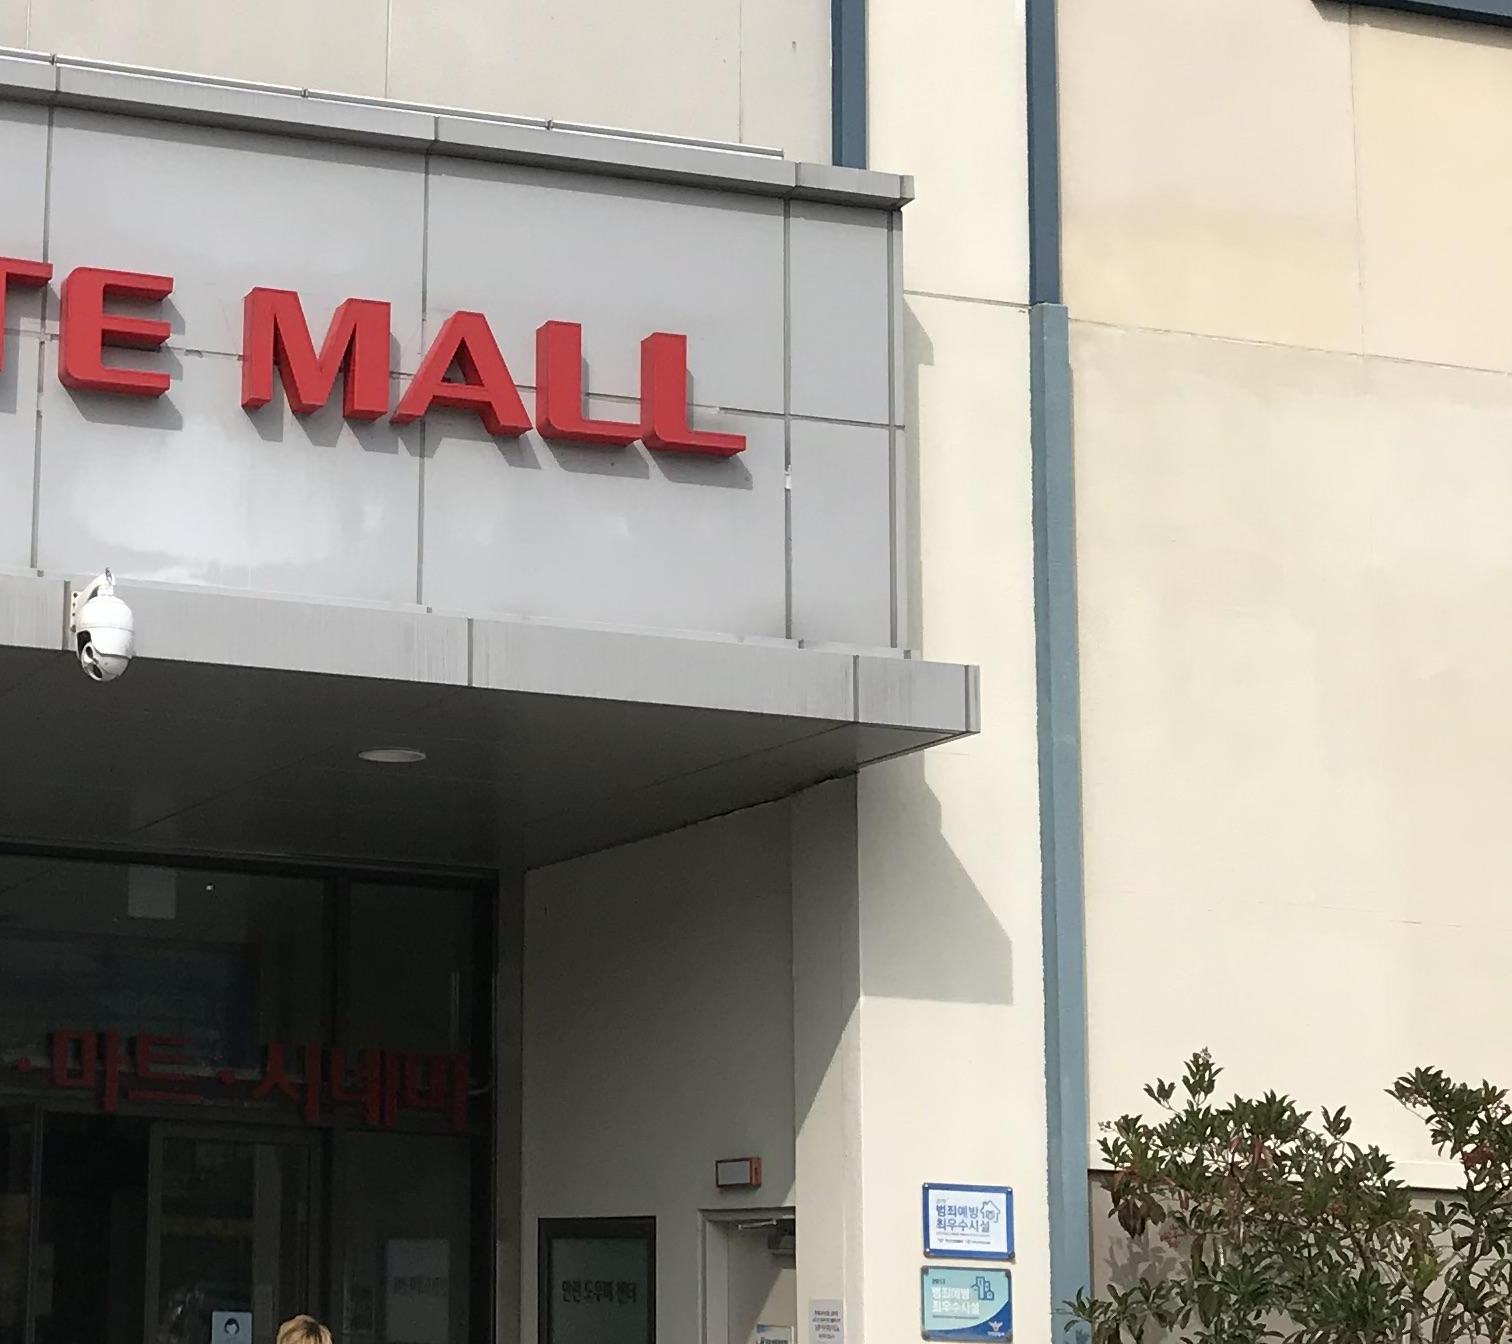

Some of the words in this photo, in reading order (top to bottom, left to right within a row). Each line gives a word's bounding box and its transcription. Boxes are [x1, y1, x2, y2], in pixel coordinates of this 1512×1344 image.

[241, 286, 747, 457] MALL
[49, 1029, 206, 1113] 마트
[935, 1203, 979, 1219] 범죄예방
[935, 1218, 991, 1233] 최우수시설
